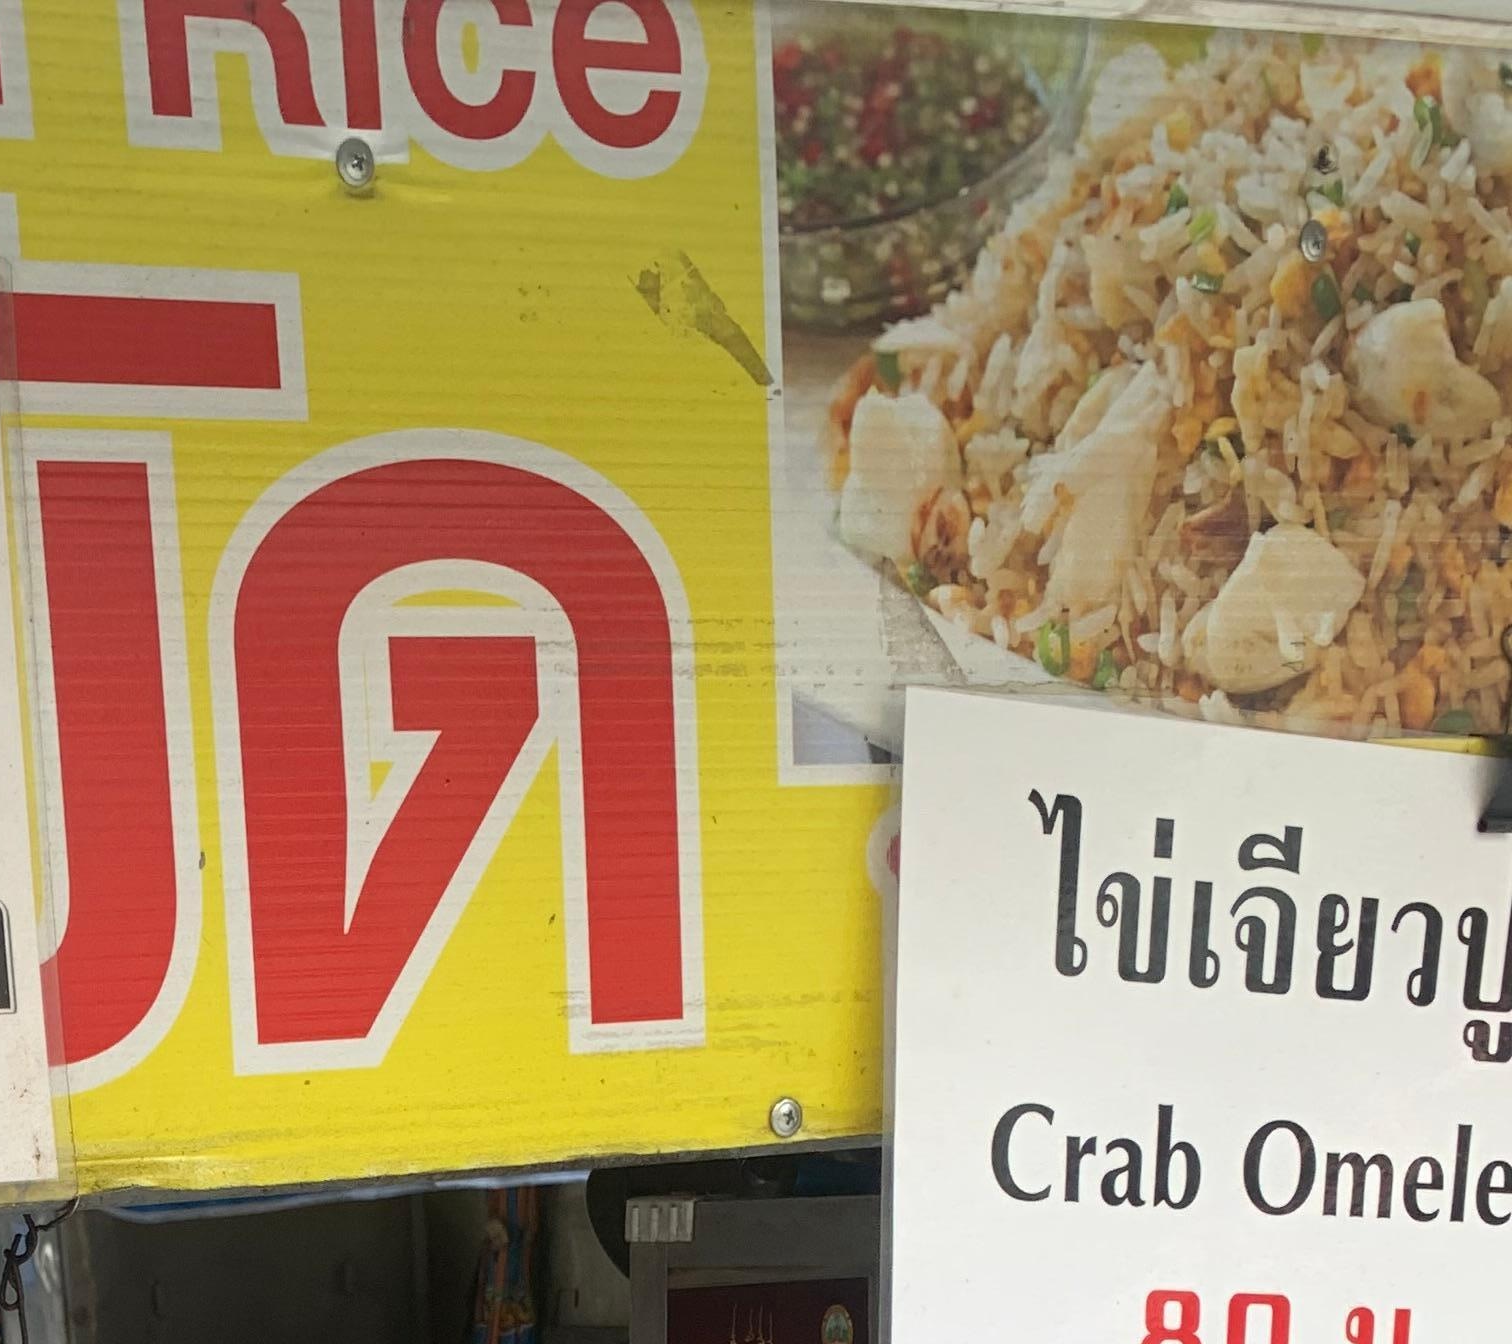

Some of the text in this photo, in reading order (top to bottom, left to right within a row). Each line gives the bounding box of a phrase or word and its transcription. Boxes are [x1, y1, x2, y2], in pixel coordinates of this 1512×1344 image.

[145, 0, 682, 148] Rice
[990, 1103, 1512, 1227] Crab Omele
